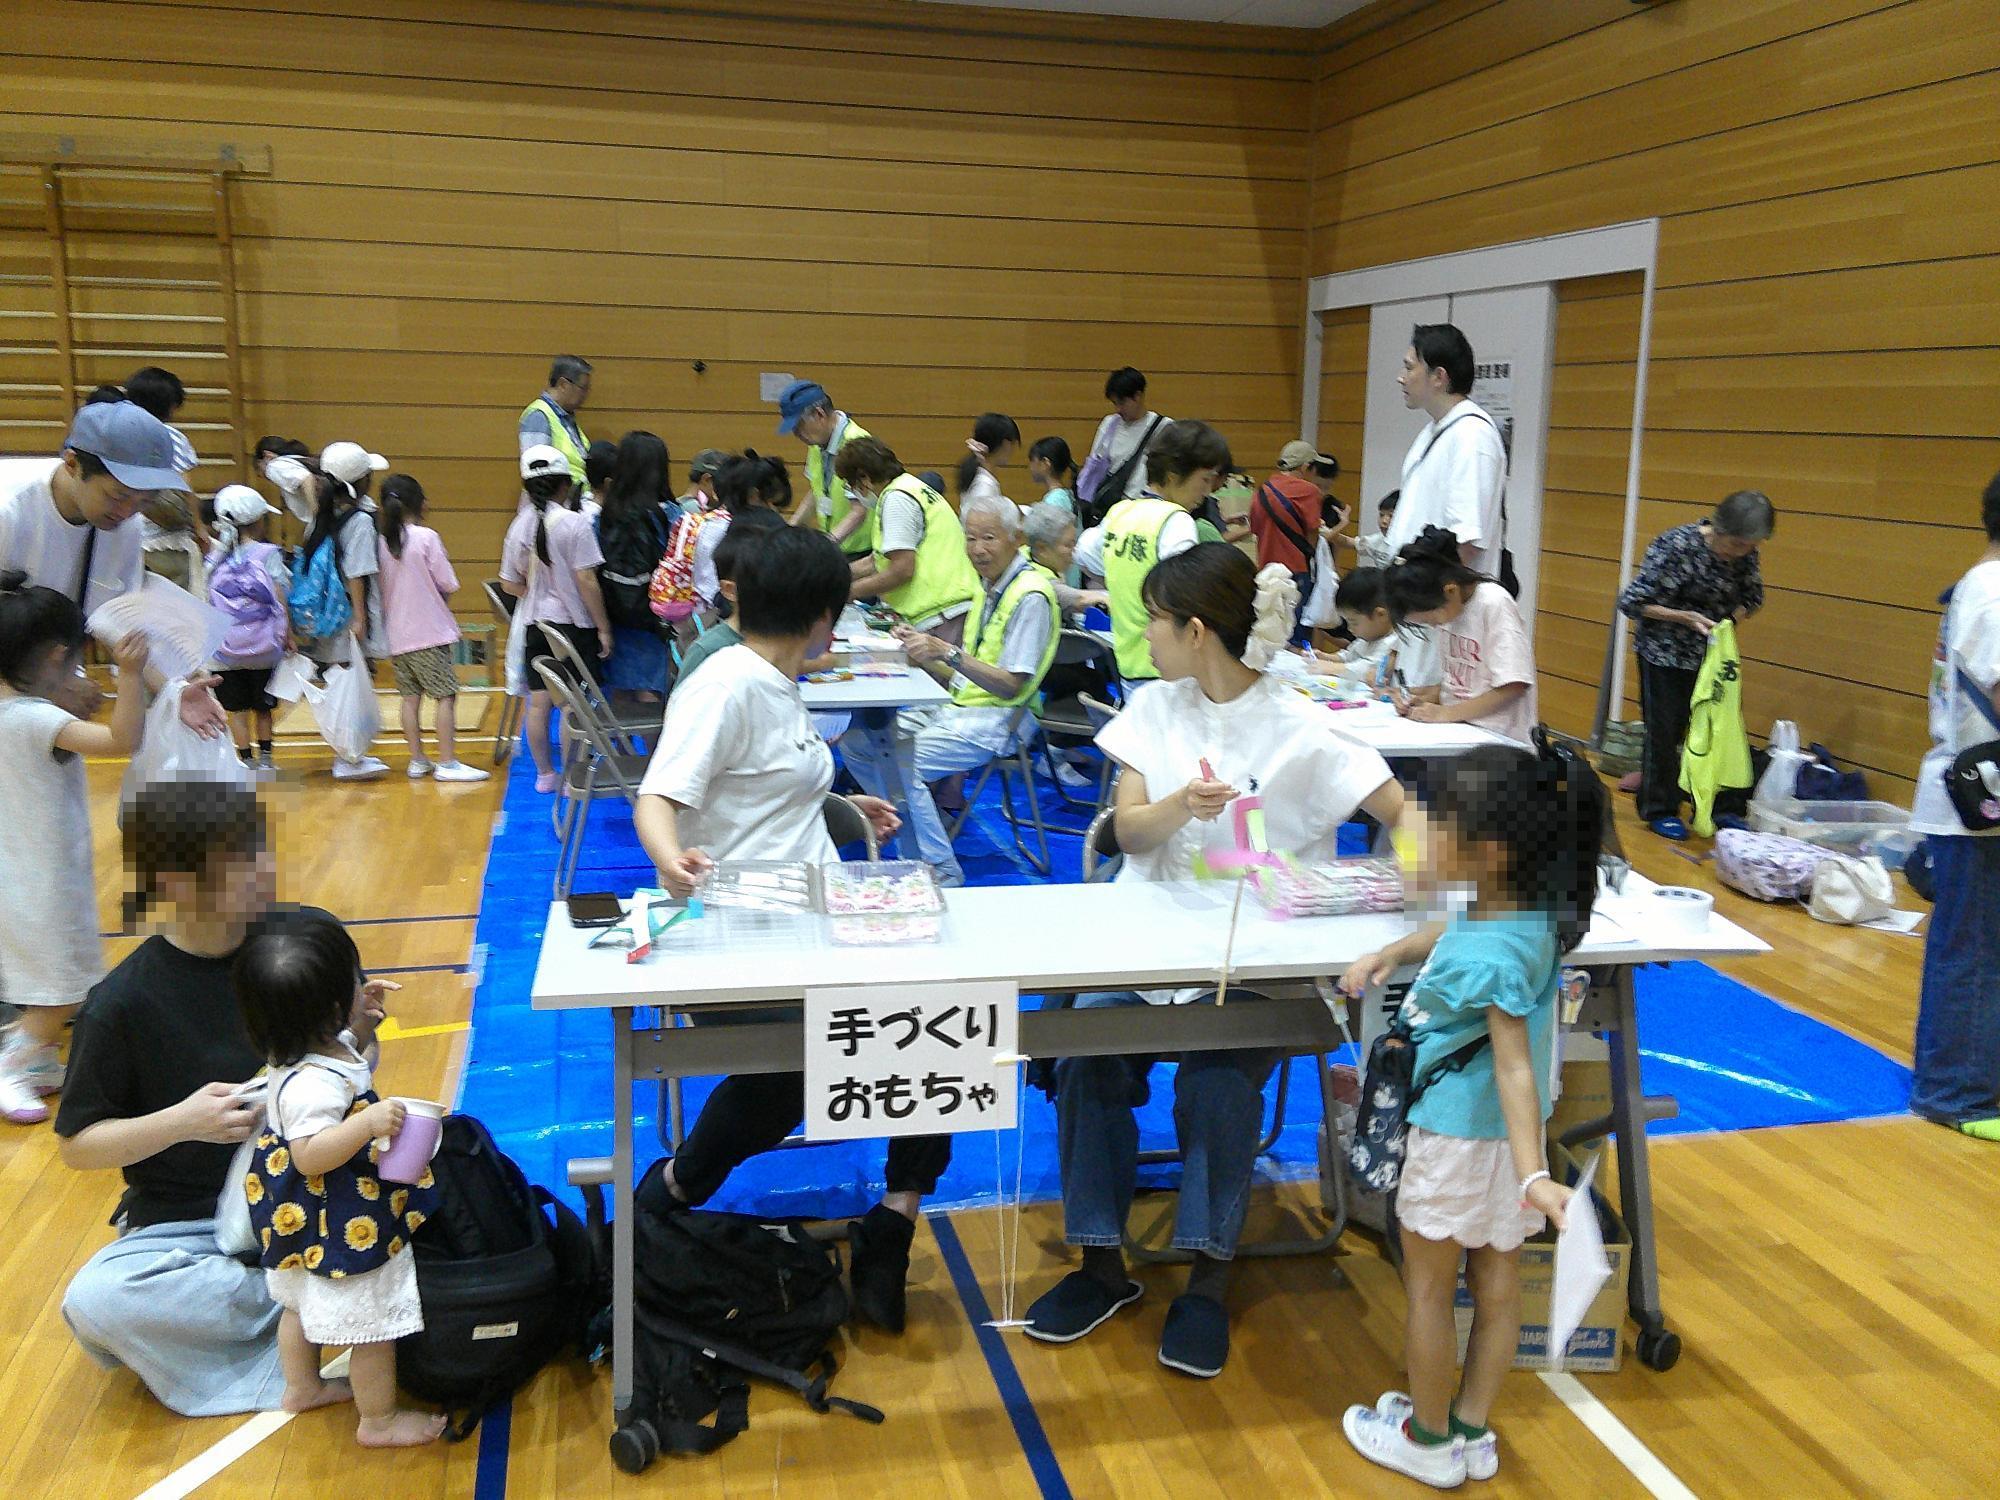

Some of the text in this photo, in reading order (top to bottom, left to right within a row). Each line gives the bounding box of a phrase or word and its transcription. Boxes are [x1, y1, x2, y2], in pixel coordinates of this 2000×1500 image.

[827, 1003, 998, 1056] 手づくり
[827, 1071, 998, 1122] おもちゃ
